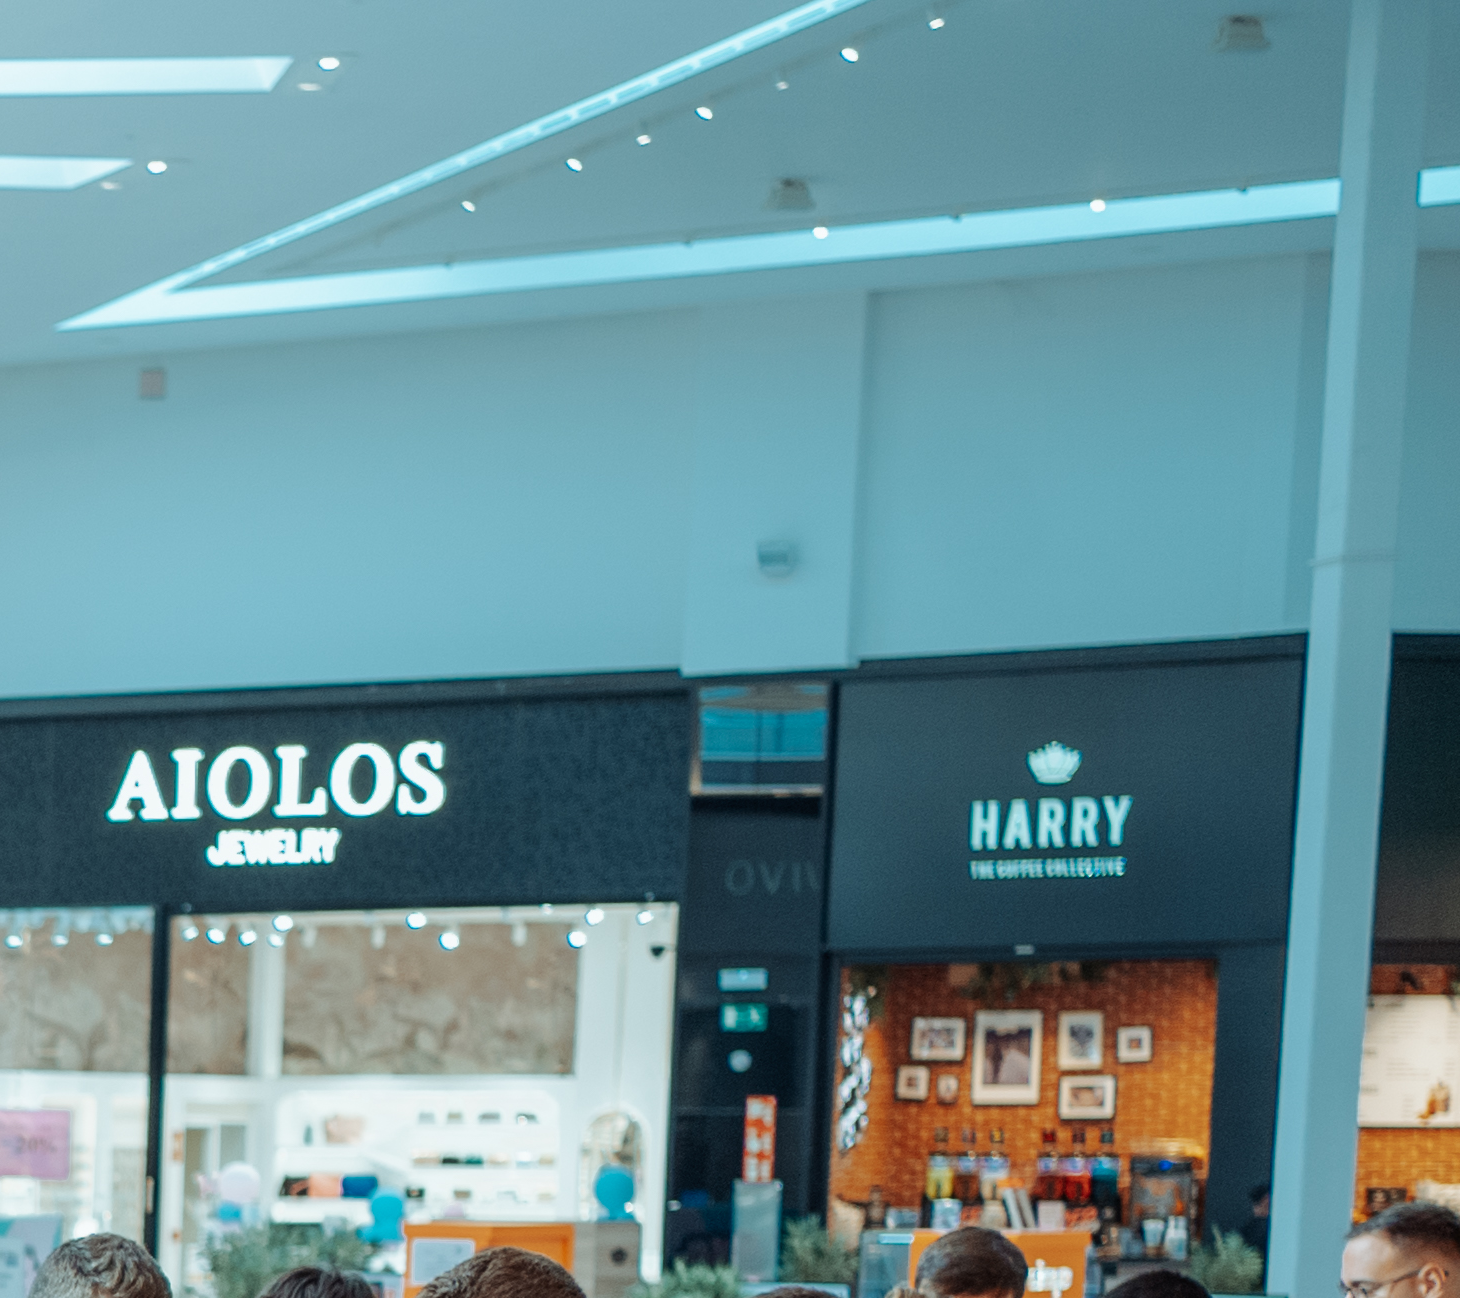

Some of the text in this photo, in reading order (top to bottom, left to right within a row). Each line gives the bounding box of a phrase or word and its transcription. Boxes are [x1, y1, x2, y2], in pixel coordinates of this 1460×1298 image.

[105, 741, 447, 823] AIOLOS
[206, 827, 342, 866] JEWELRY
[969, 795, 1134, 852] HARRY
